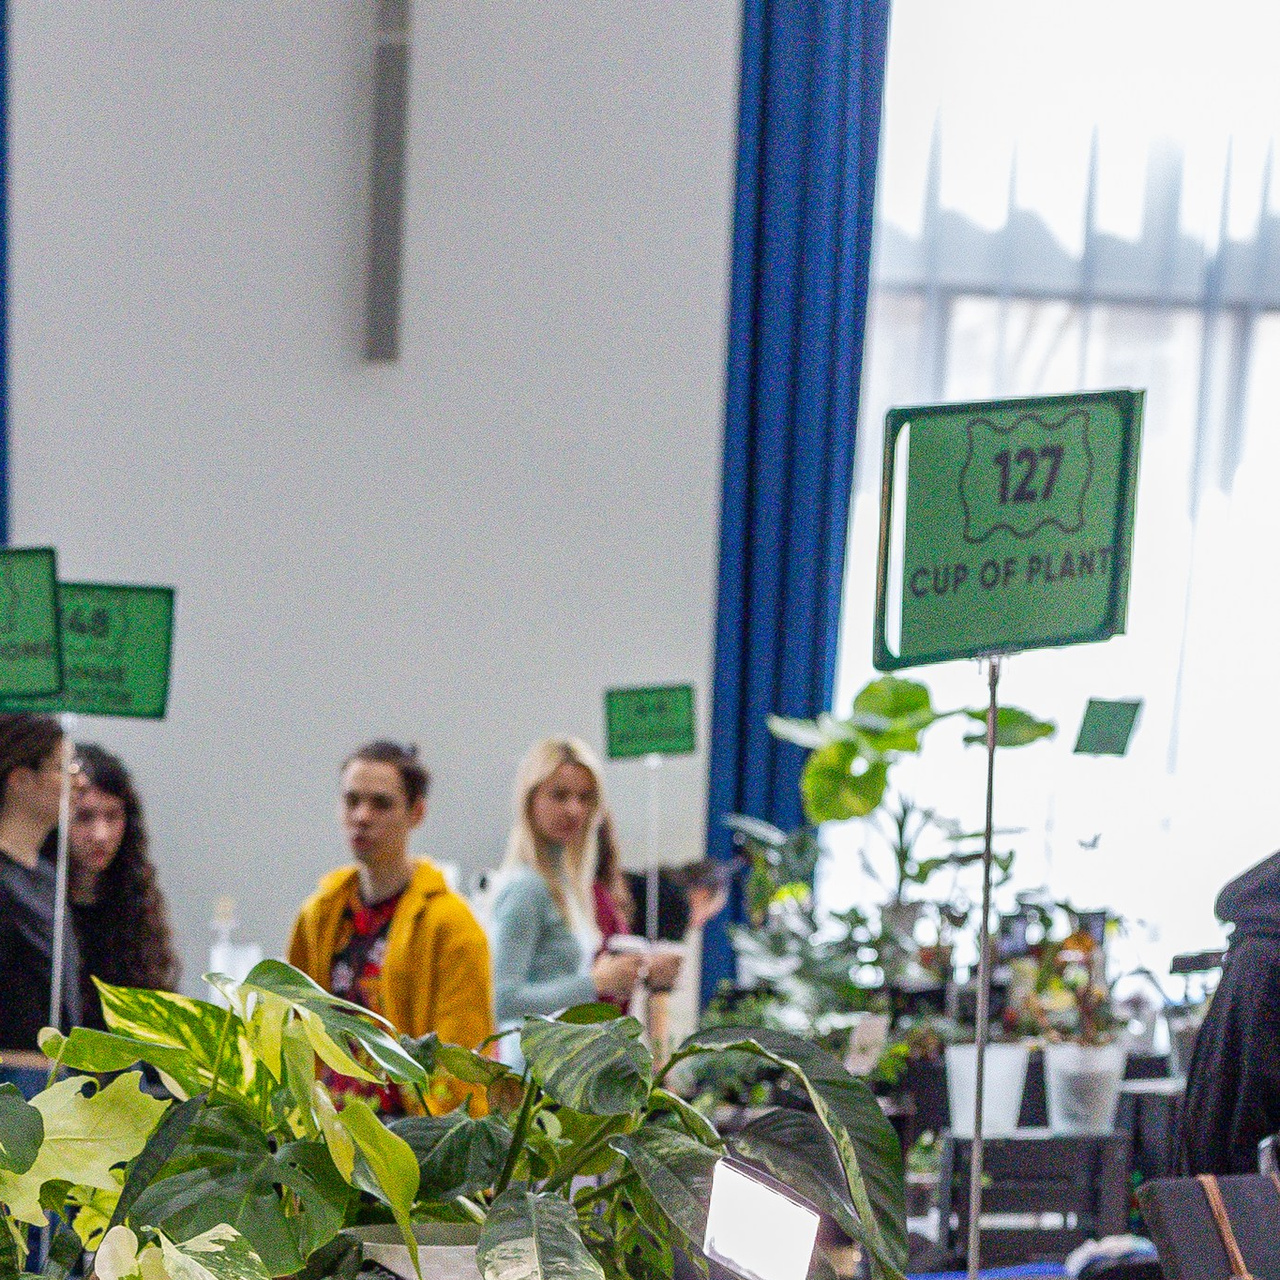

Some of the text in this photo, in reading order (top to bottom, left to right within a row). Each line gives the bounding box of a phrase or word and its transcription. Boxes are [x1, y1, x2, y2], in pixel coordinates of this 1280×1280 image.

[994, 445, 1065, 505] 127
[910, 548, 1114, 597] CUP OF PLANT
